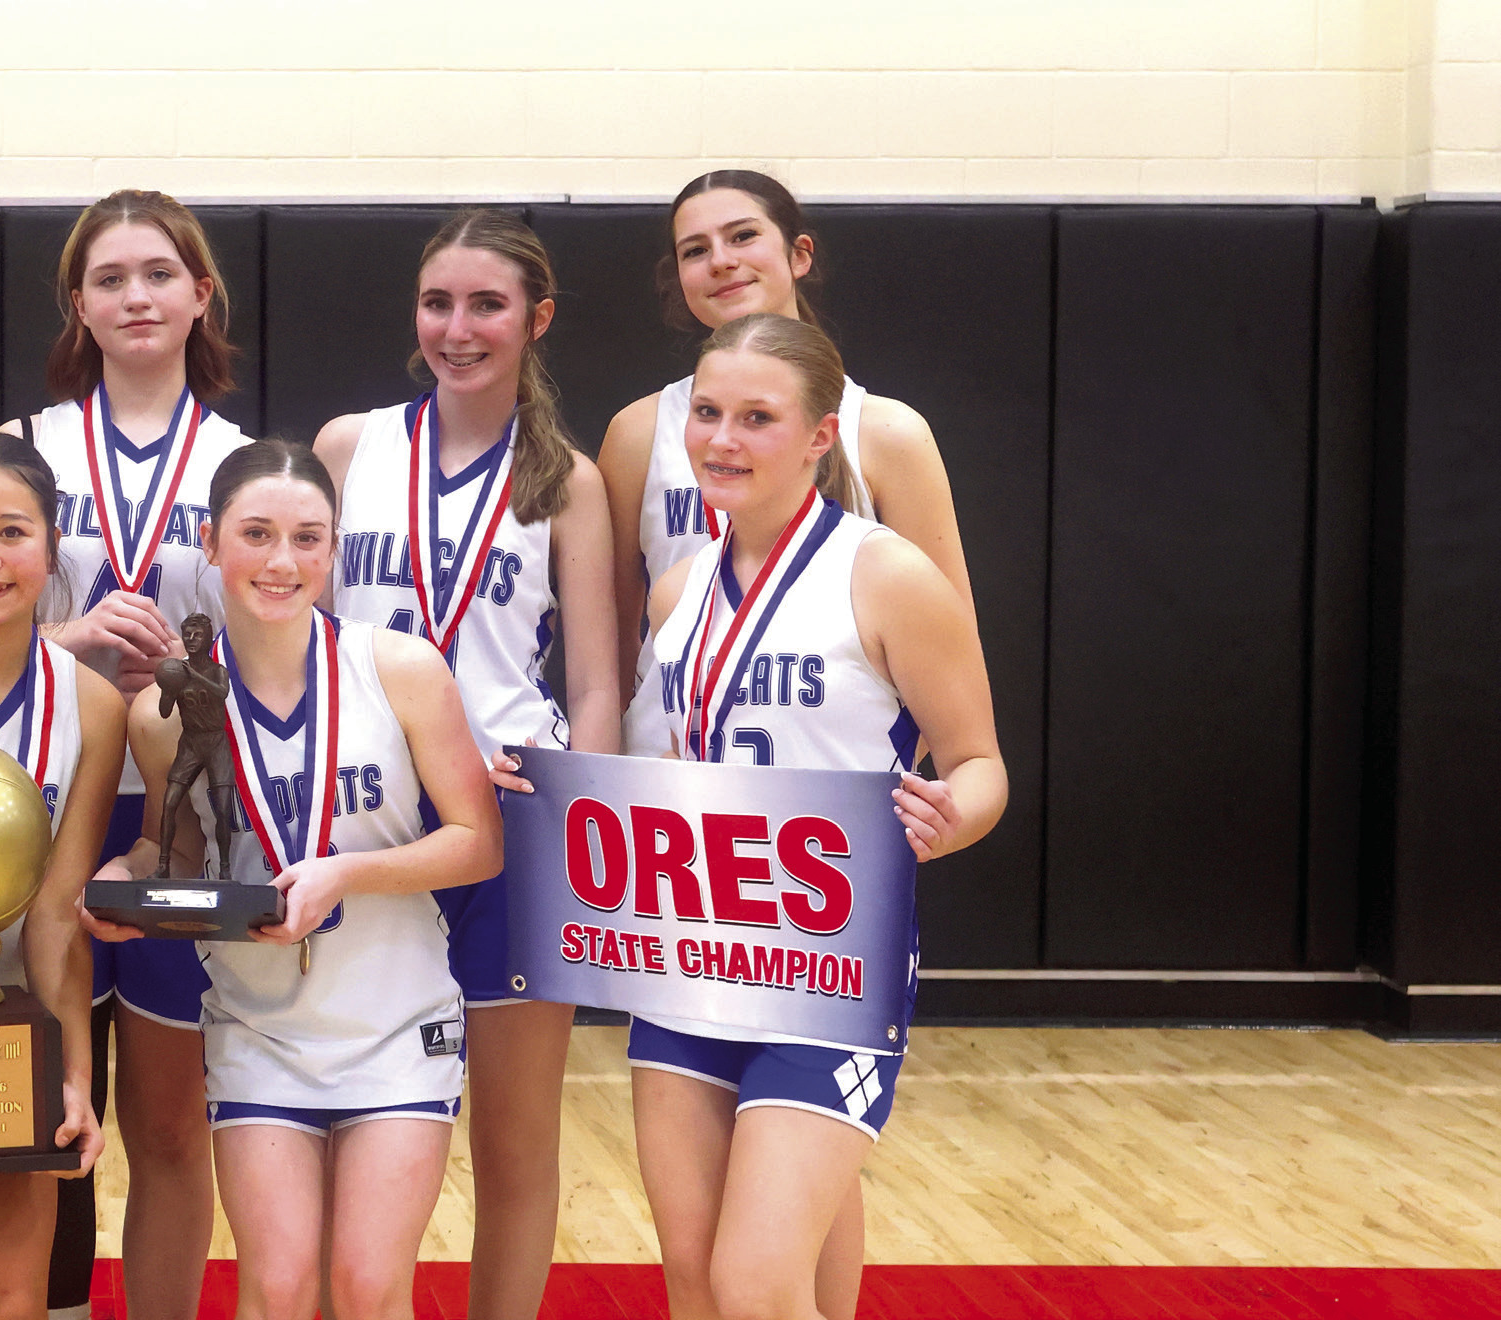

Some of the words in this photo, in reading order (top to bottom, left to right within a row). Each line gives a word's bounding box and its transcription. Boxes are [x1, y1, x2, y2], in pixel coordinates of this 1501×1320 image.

[565, 796, 854, 935] ORES
[560, 922, 667, 974] STATE
[676, 938, 864, 1000] CHAMPION
